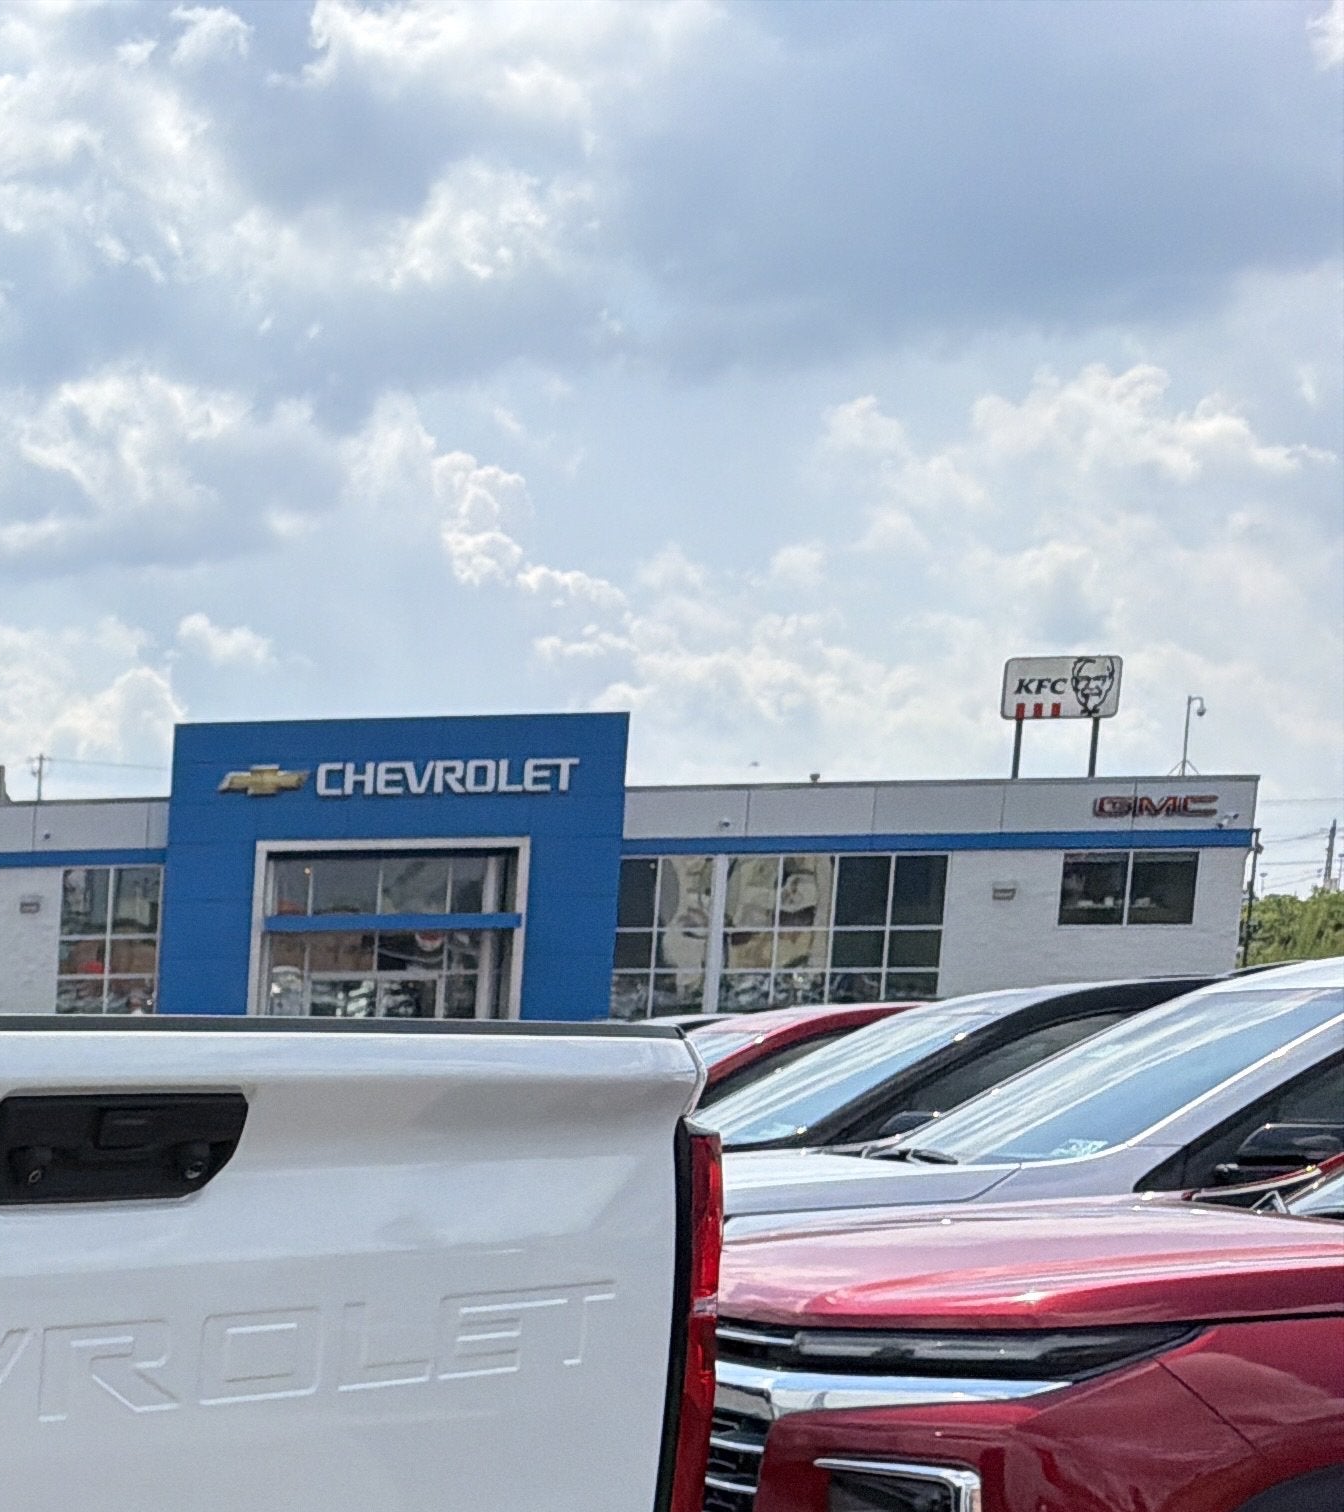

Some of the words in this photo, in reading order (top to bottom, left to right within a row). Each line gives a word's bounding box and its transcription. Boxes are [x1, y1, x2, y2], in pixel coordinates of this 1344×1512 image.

[1014, 677, 1068, 695] KFC
[316, 757, 580, 797] CHEVROLET
[1092, 794, 1219, 819] GMC
